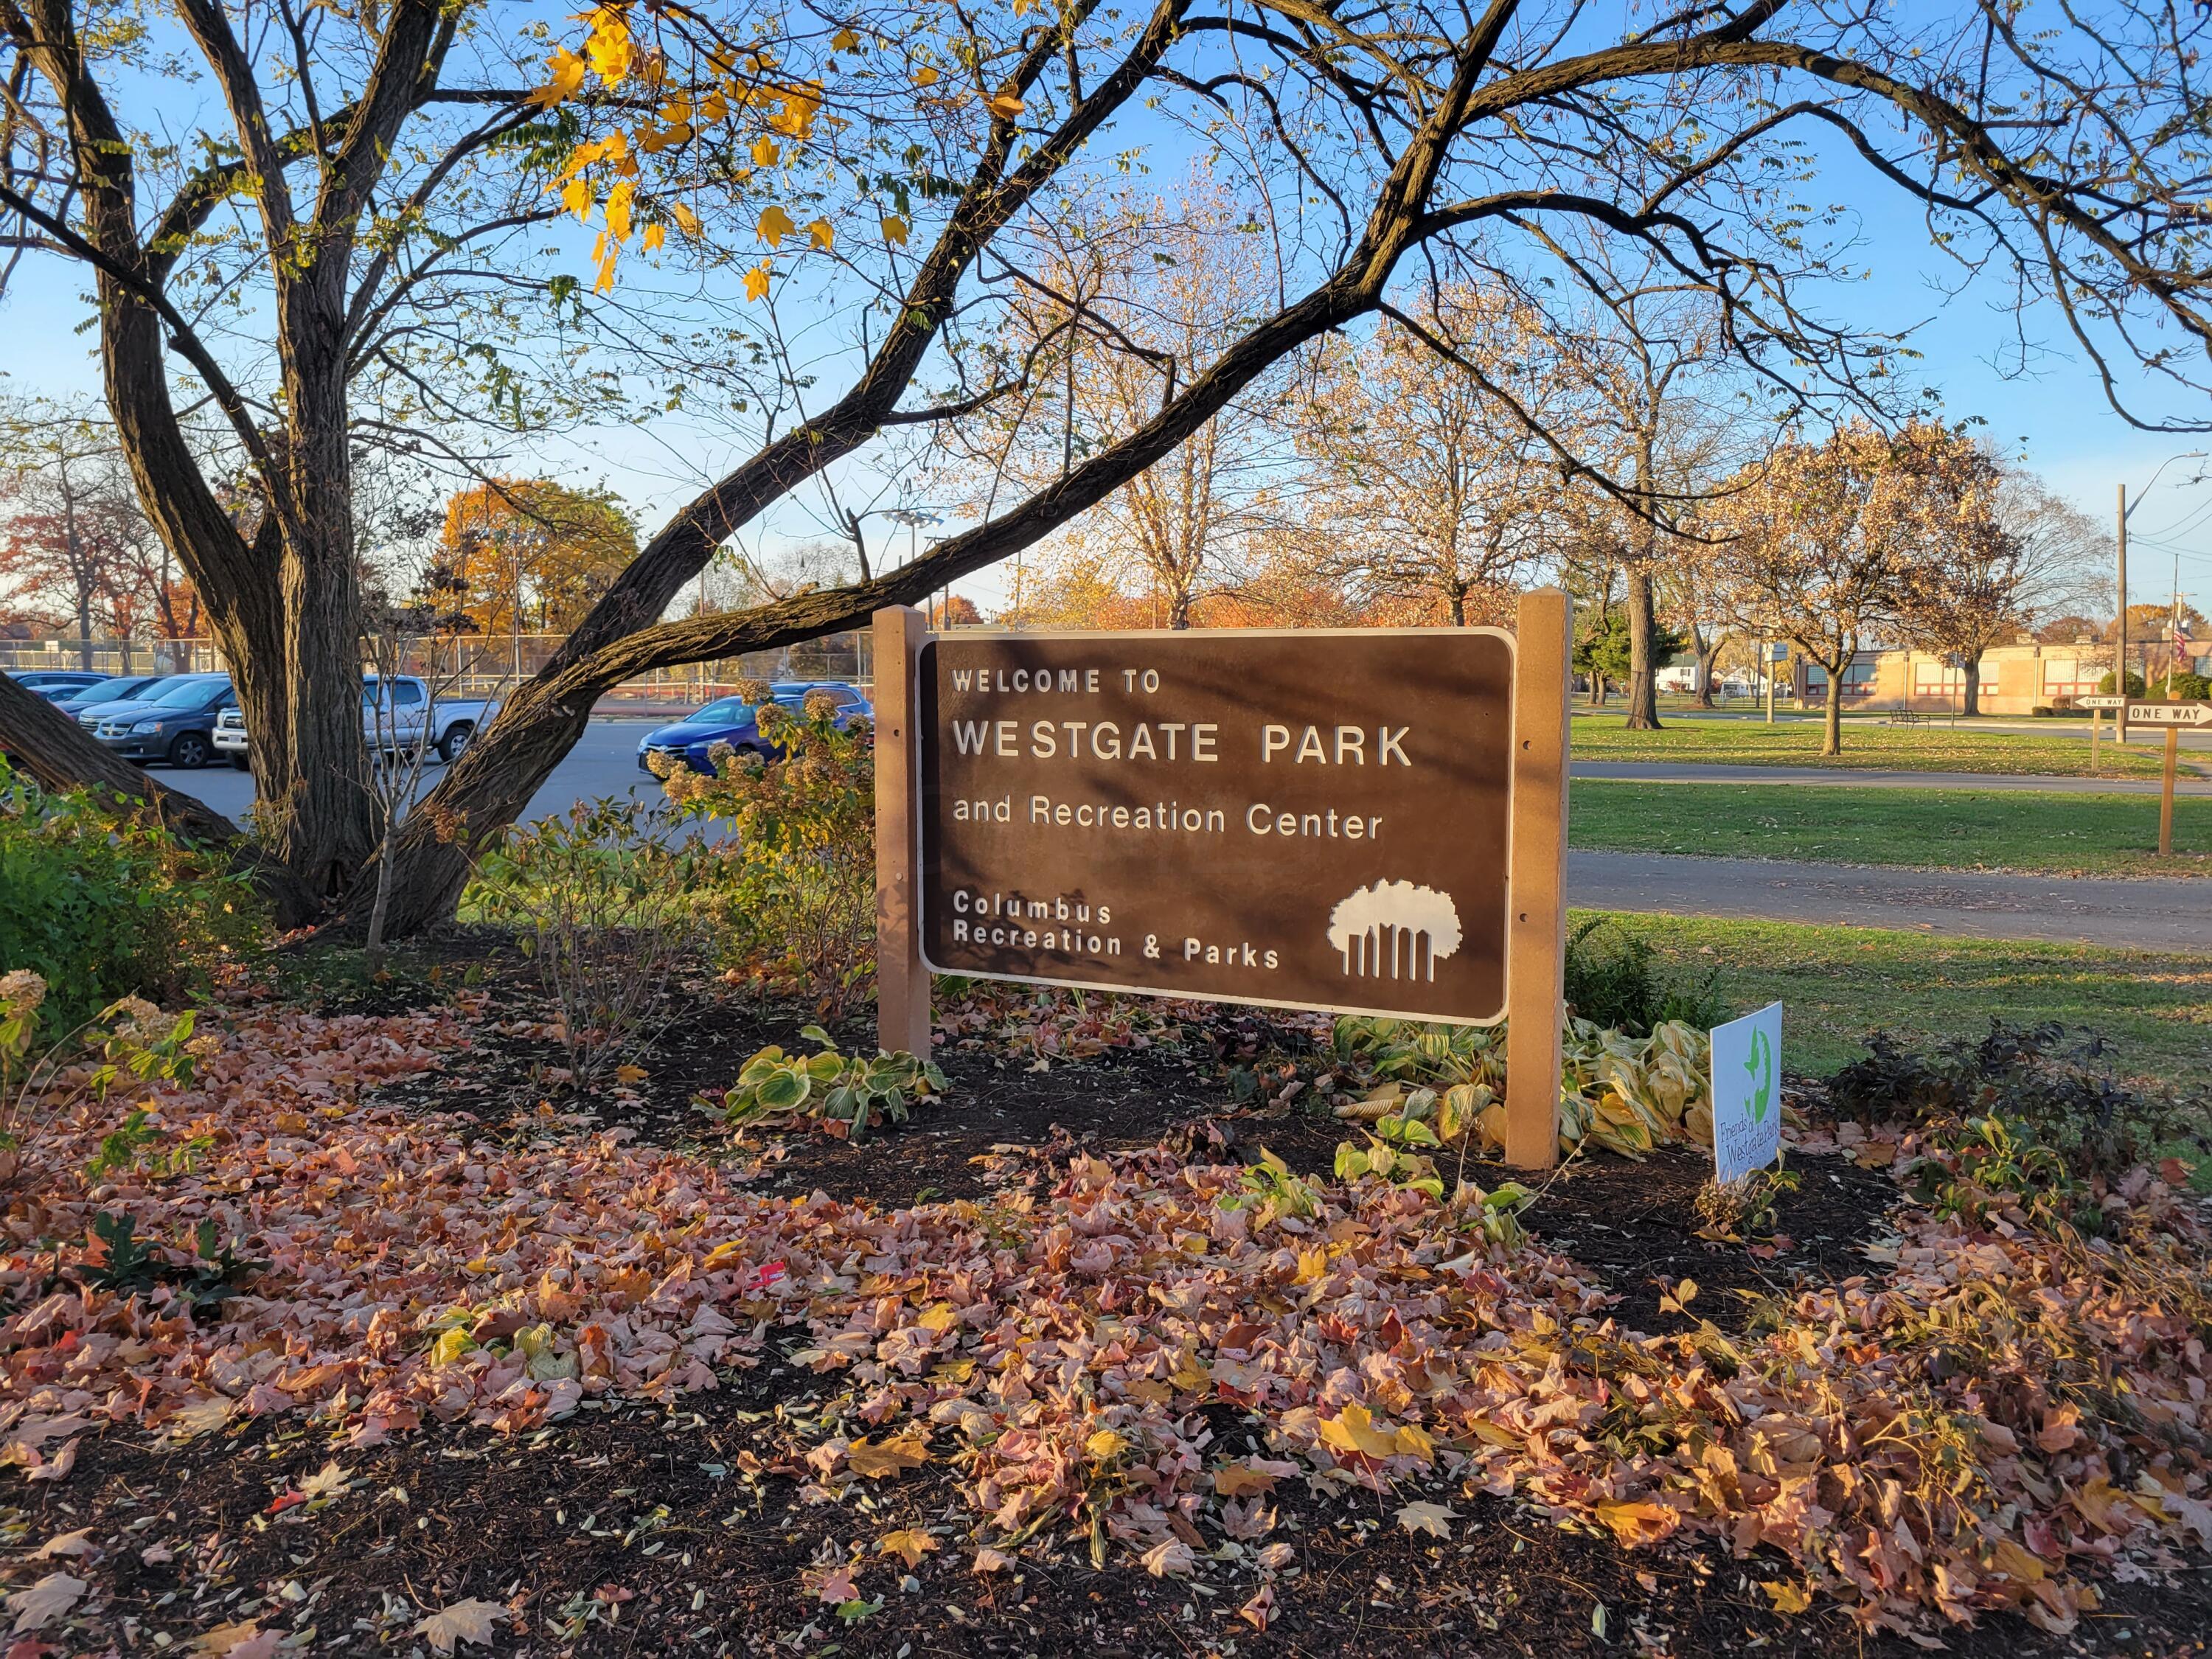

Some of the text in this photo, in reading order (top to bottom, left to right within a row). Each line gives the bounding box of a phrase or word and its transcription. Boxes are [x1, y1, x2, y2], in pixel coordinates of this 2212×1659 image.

[951, 668, 1161, 694] WELCOME TO
[2132, 708, 2200, 720] ONE WAY
[952, 720, 1412, 768] WESTGATE PARK
[953, 795, 1383, 841] and Recreation Center
[953, 889, 1111, 924] Columbus
[953, 919, 1280, 971] Recreation & Parks
[1720, 1112, 1755, 1143] Friends of
[1726, 1112, 1779, 1166] Westgate Park
